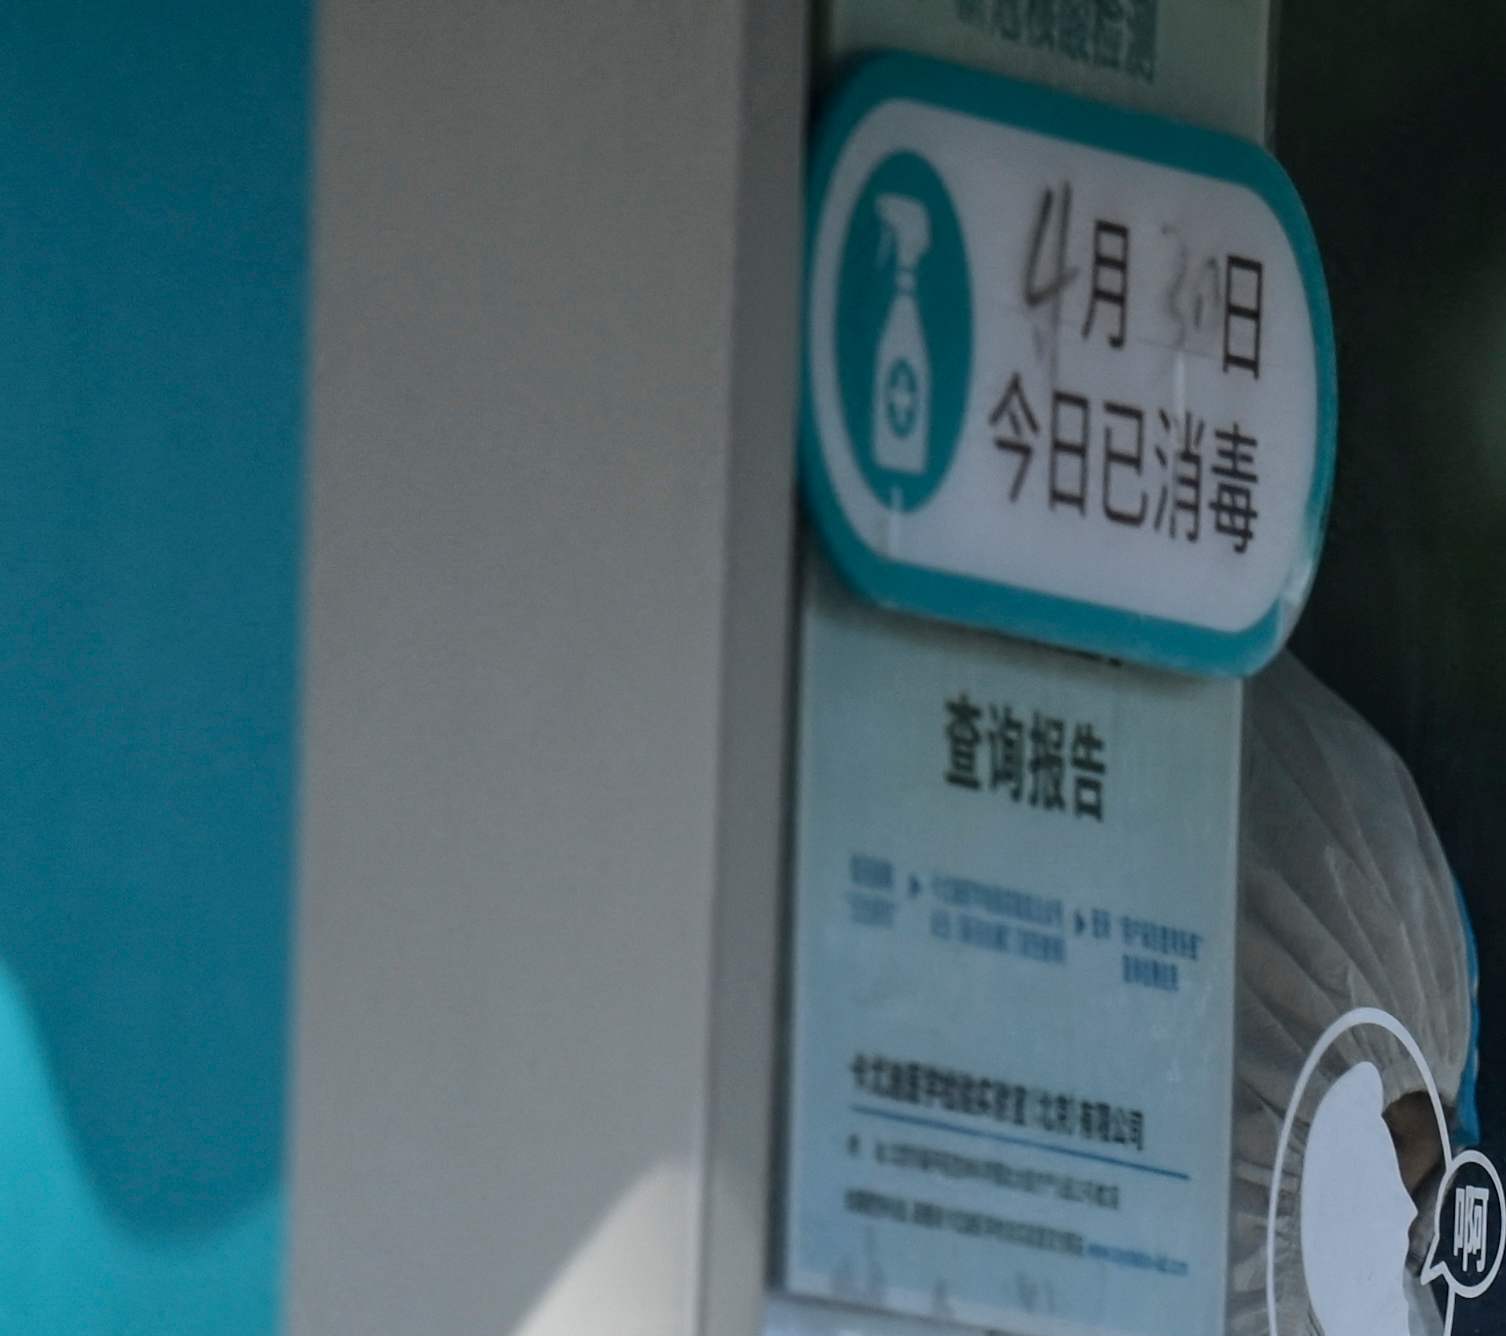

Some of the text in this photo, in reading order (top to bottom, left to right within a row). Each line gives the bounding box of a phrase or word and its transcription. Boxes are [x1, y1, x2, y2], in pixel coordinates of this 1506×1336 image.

[987, 371, 1260, 555] 今日已消毒
[943, 692, 1108, 824] 查询报告
[1453, 1183, 1490, 1273] 啊
